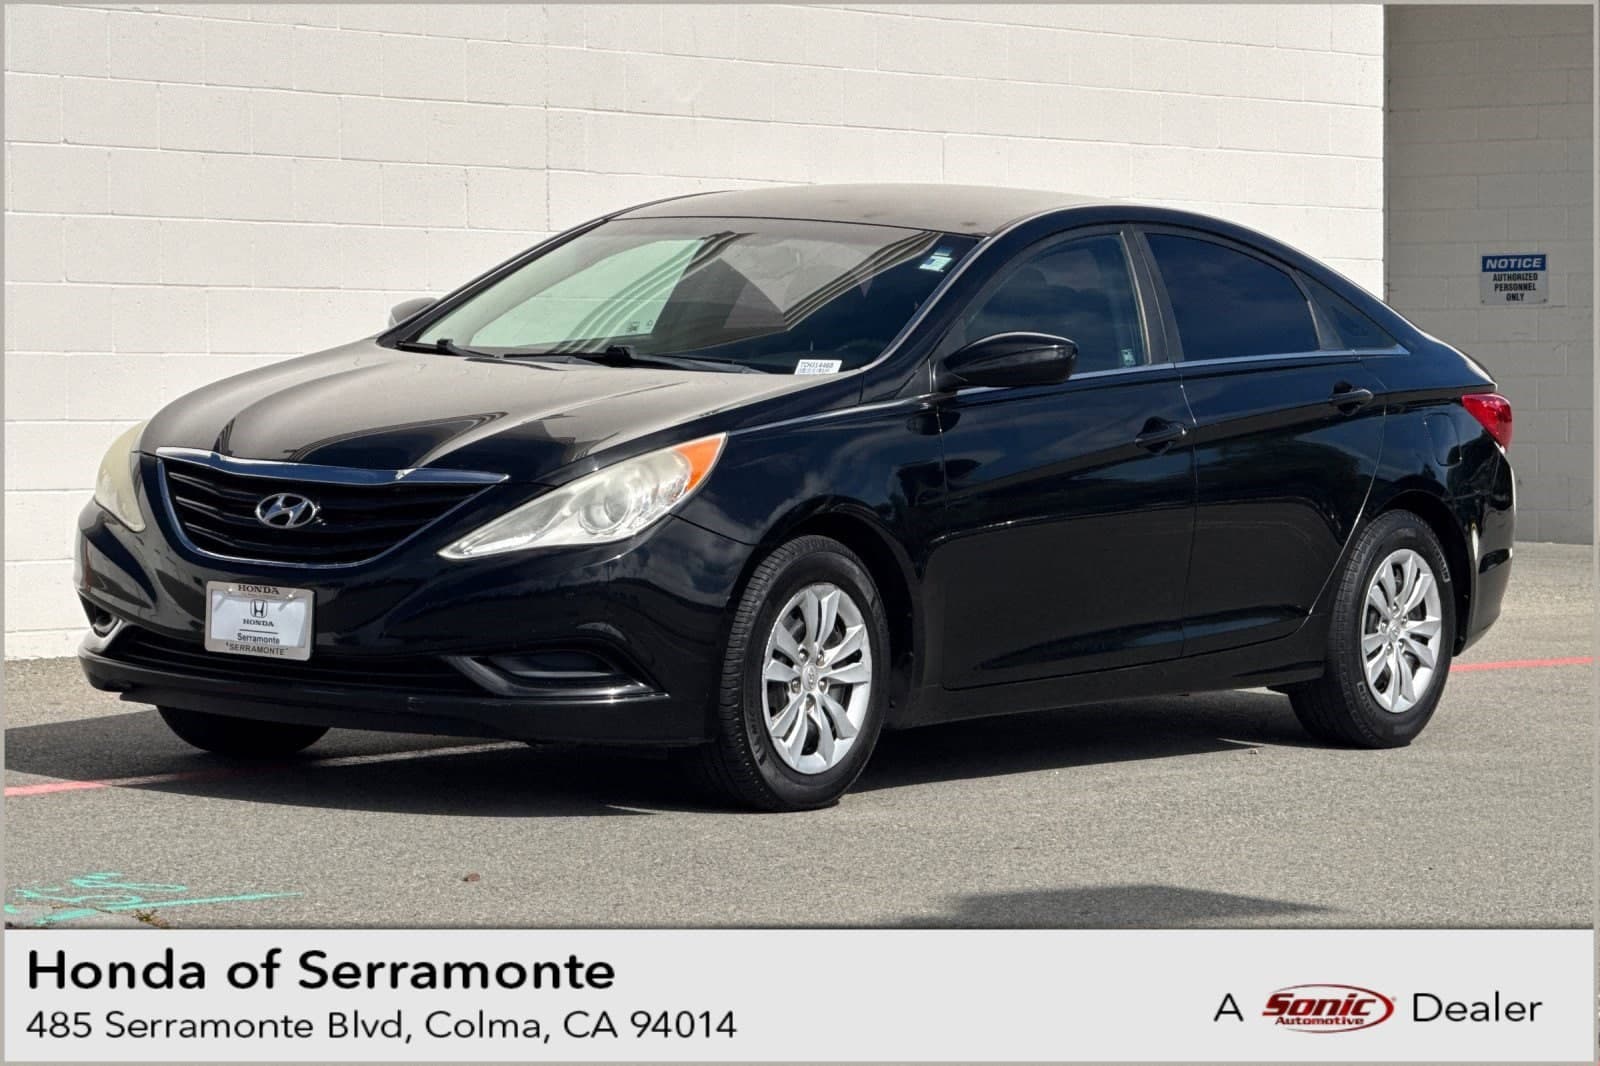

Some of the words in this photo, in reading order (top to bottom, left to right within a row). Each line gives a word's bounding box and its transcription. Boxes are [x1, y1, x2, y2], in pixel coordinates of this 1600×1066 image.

[1486, 258, 1542, 269] NOTICE
[1493, 273, 1538, 282] AUTHORIZED
[1494, 283, 1536, 292] PERSONNEL
[1506, 293, 1524, 301] ONLY
[238, 585, 280, 595] HONDA
[243, 618, 274, 627] HONDA
[237, 632, 280, 644] Serramonte
